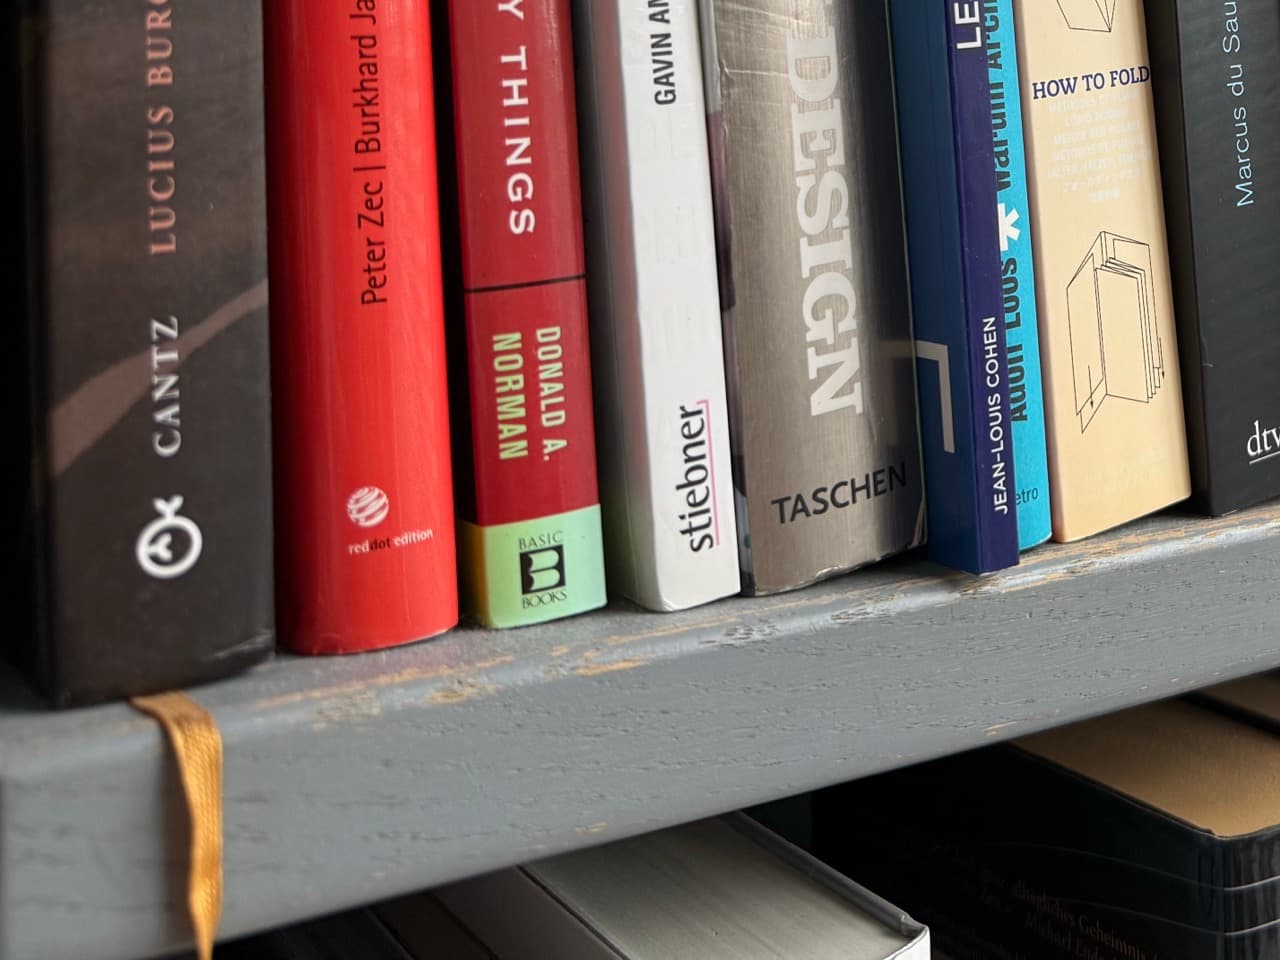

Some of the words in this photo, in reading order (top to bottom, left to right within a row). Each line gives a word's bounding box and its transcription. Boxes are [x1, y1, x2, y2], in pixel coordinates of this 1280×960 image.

[953, 0, 983, 51] LE
[353, 32, 382, 155] Burkhard
[654, 33, 677, 106] GAVIN
[1032, 77, 1078, 100] HOW
[1082, 73, 1105, 92] TO
[1109, 66, 1150, 87] FOLD
[1224, 62, 1245, 97] du
[499, 47, 536, 236] THINGS
[1226, 105, 1255, 207] Marcus
[150, 104, 177, 254] LUCIUS
[357, 182, 385, 226] Zec
[787, 25, 864, 418] DESIGN
[359, 228, 389, 306] Peter
[152, 315, 181, 458] CANTZ
[536, 326, 566, 430] DONALD
[982, 317, 1001, 388] COHEN
[492, 331, 528, 460] NORMAN
[543, 438, 567, 462] A.
[678, 405, 714, 552] stiebner
[981, 391, 1009, 515] JEAN-LOUIS
[771, 462, 907, 525] TASCHEN
[1015, 486, 1039, 506] etro
[394, 528, 434, 547] edition
[519, 530, 564, 550] BASIC
[522, 590, 567, 609] BOOKS
